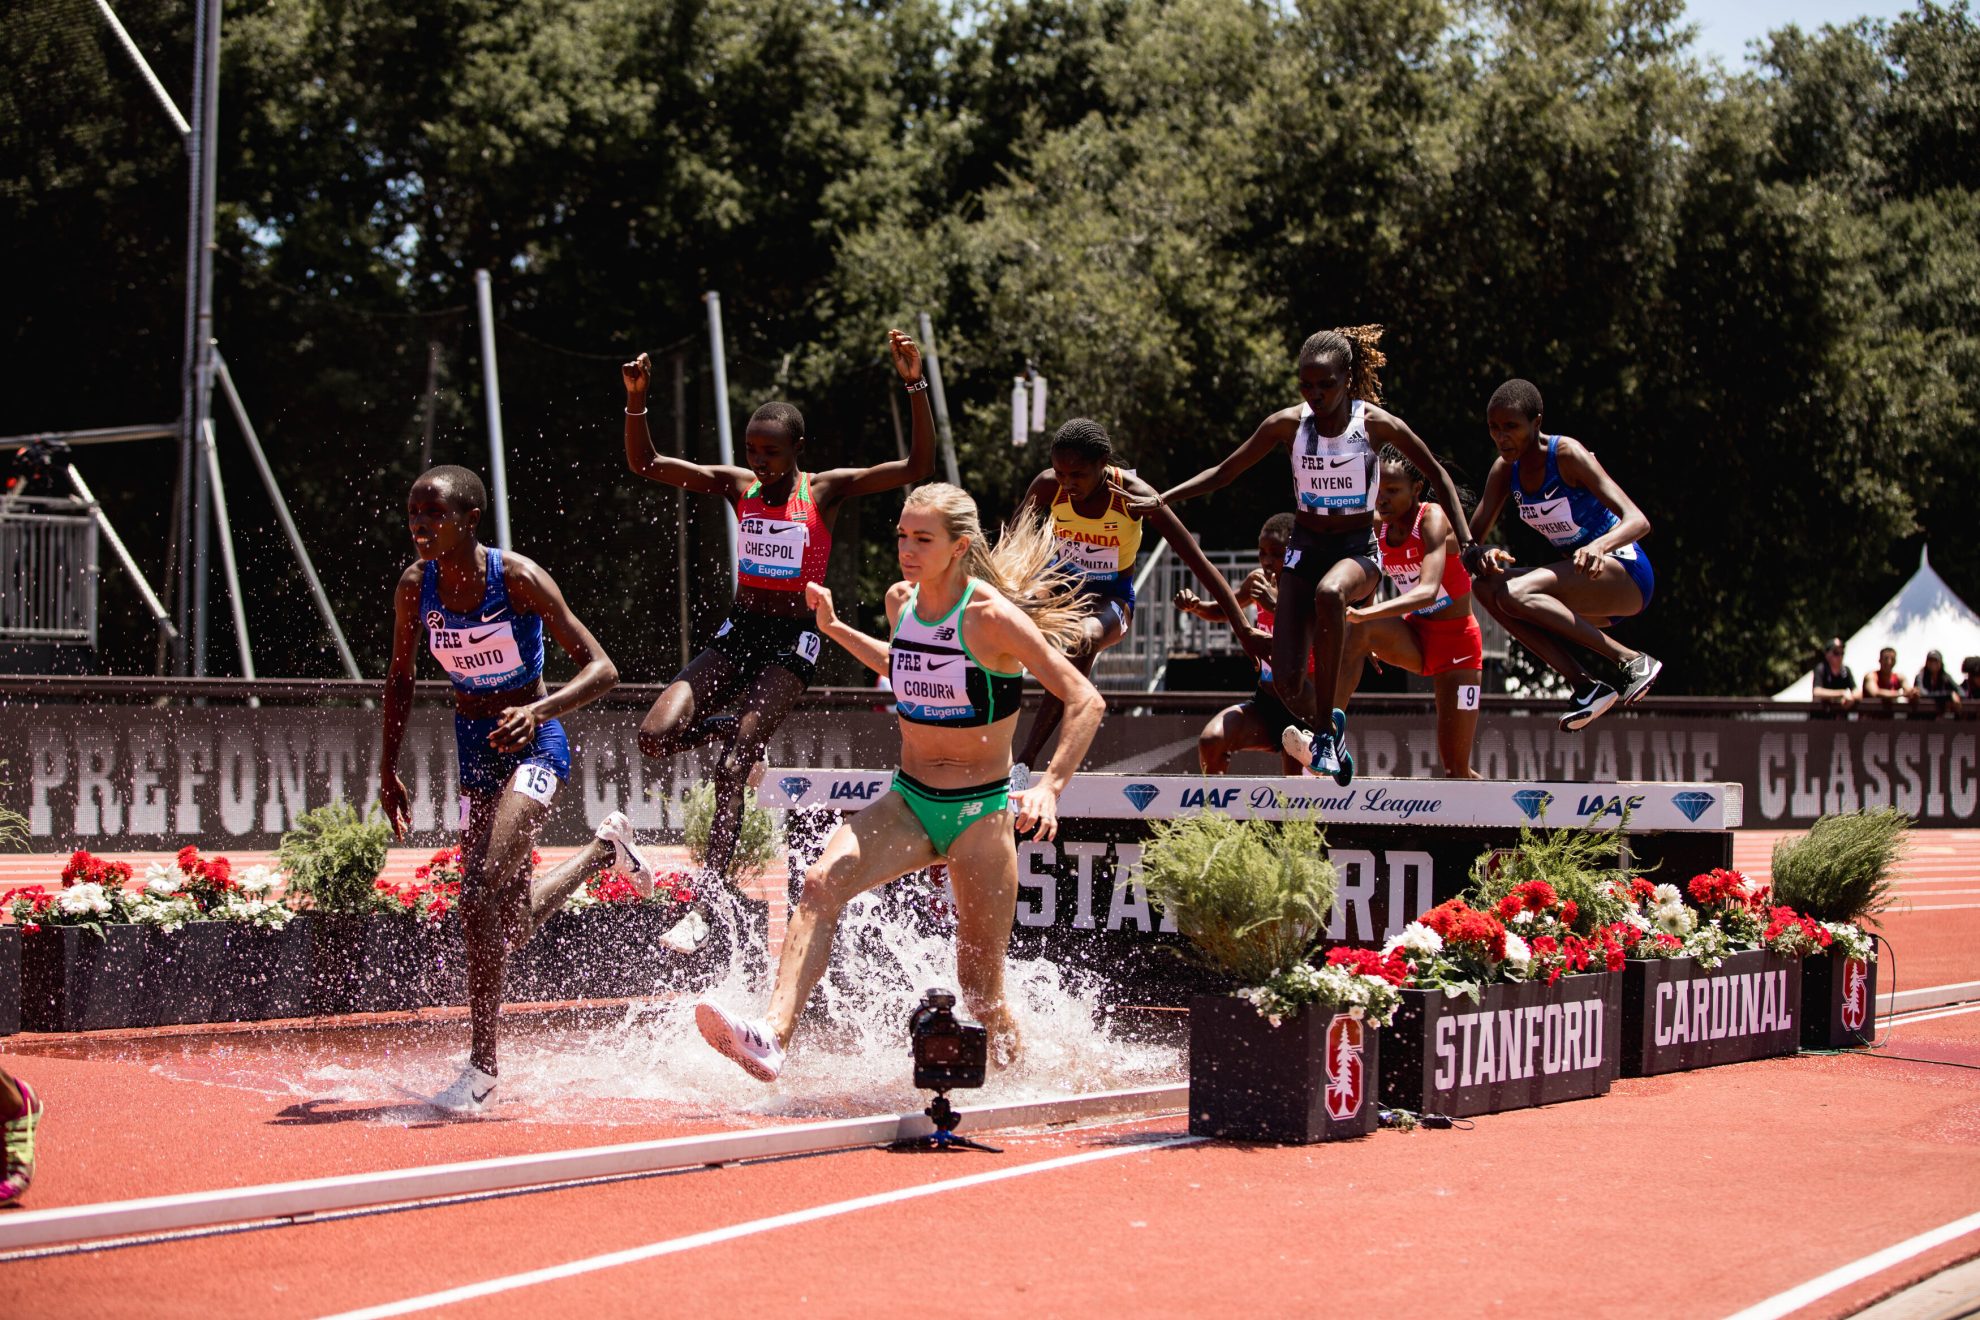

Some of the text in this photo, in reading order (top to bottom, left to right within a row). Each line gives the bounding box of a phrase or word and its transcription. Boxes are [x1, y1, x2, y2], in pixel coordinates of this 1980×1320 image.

[1302, 456, 1324, 470] PRE
[1311, 477, 1353, 490] KIYENG
[1324, 497, 1360, 507] Eugene
[1521, 506, 1539, 520] PRE
[741, 519, 763, 535] PRE
[745, 541, 795, 560] CHESPOL
[758, 565, 794, 577] Eugene
[1419, 600, 1447, 614] Eugene
[435, 631, 462, 649] PRE
[806, 634, 819, 657] 12
[452, 649, 504, 670] JERUTO
[897, 653, 922, 672] PRE
[473, 670, 518, 686] Eugene
[904, 680, 956, 700] COBURN
[1466, 686, 1476, 706] 9
[923, 705, 967, 720] Eugene
[526, 767, 549, 793] 15
[1759, 732, 1978, 820] CLASSIC
[830, 781, 884, 800] IAAF
[1179, 786, 1442, 818] IAAF Diamond League
[1017, 840, 1434, 942] STARD
[1654, 969, 1792, 1047] CARDINAL
[1435, 999, 1602, 1091] STANFORD
